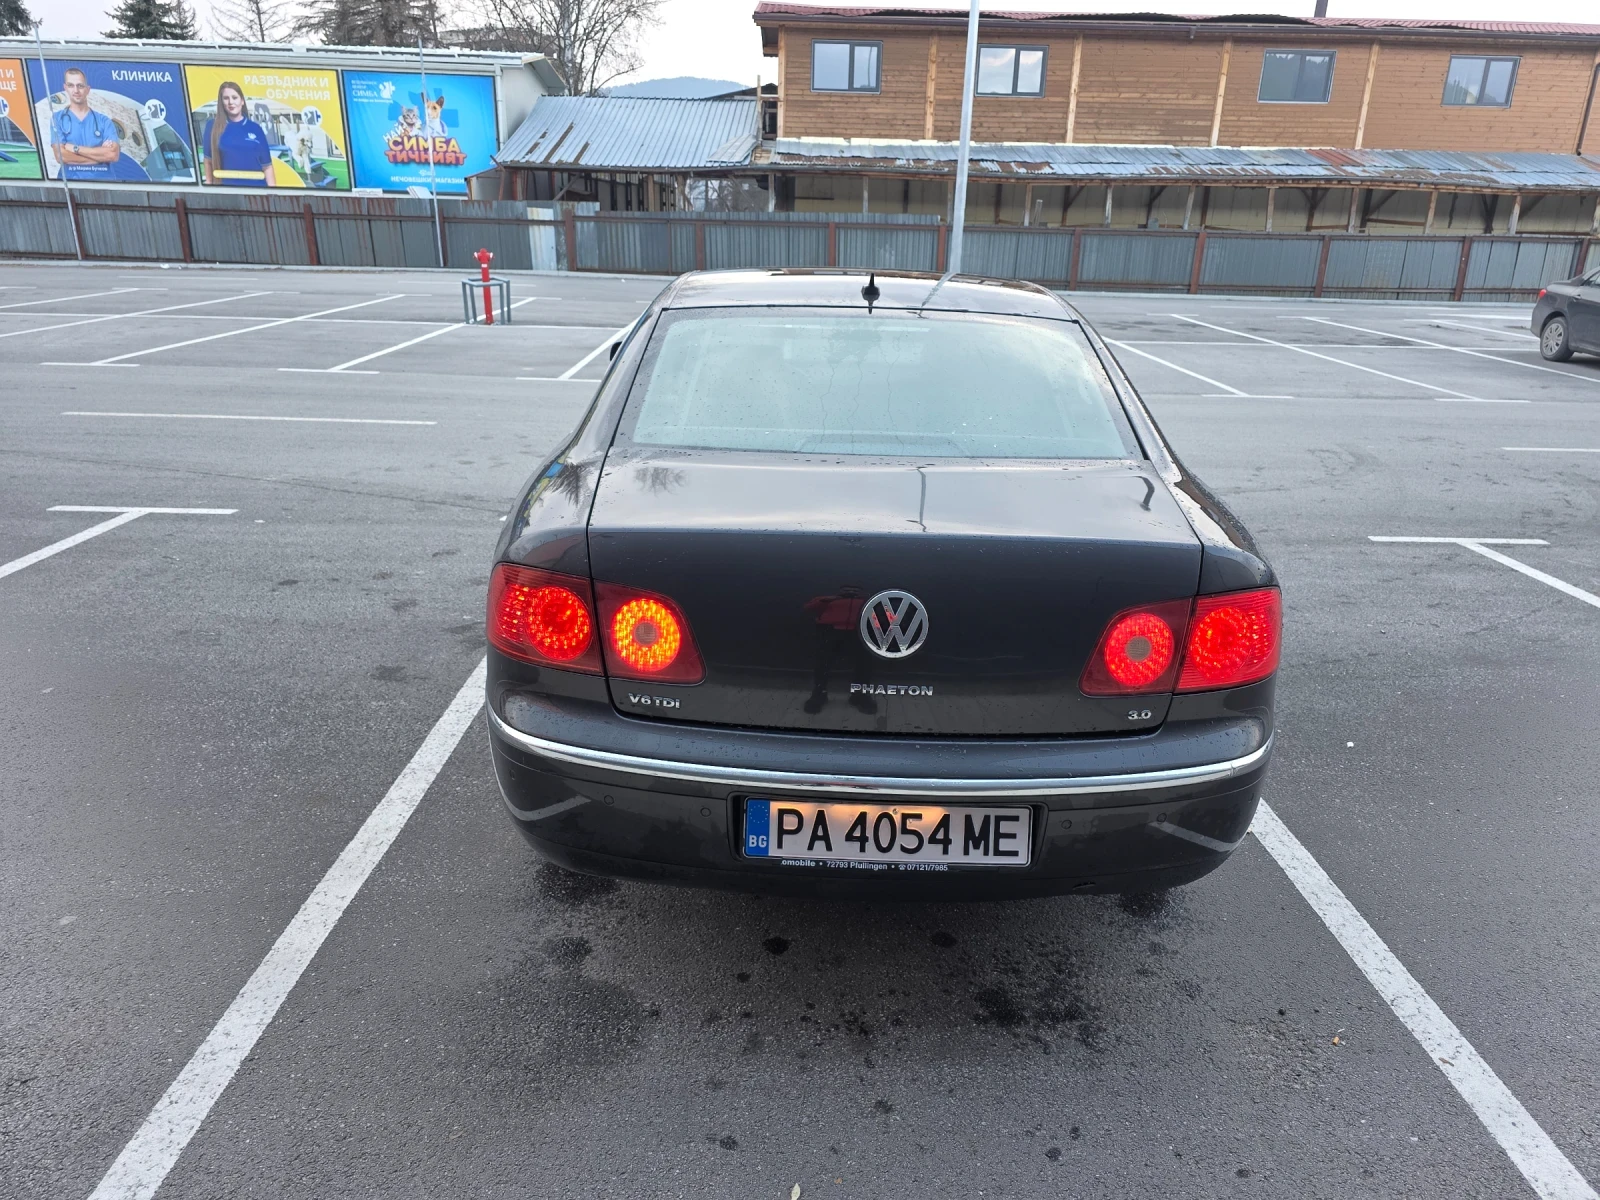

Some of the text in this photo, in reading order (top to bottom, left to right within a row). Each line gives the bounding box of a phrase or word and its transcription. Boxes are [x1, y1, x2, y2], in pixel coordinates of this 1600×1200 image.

[111, 69, 173, 83] КЛИНИКА
[243, 75, 329, 88] РАЗВЪДНИК И
[265, 88, 331, 101] ОБУЧЕНИЯ
[388, 135, 461, 154] СИМБА
[385, 150, 466, 165] ТИЧНИЯТ
[850, 683, 934, 697] PHAETON
[1127, 709, 1152, 720] 3.0
[776, 807, 1020, 857] PA 4054 ME
[748, 834, 767, 848] BG
[826, 861, 849, 869] 72793
[850, 861, 888, 871] Pfullingen
[907, 863, 948, 871] 07121/7985
